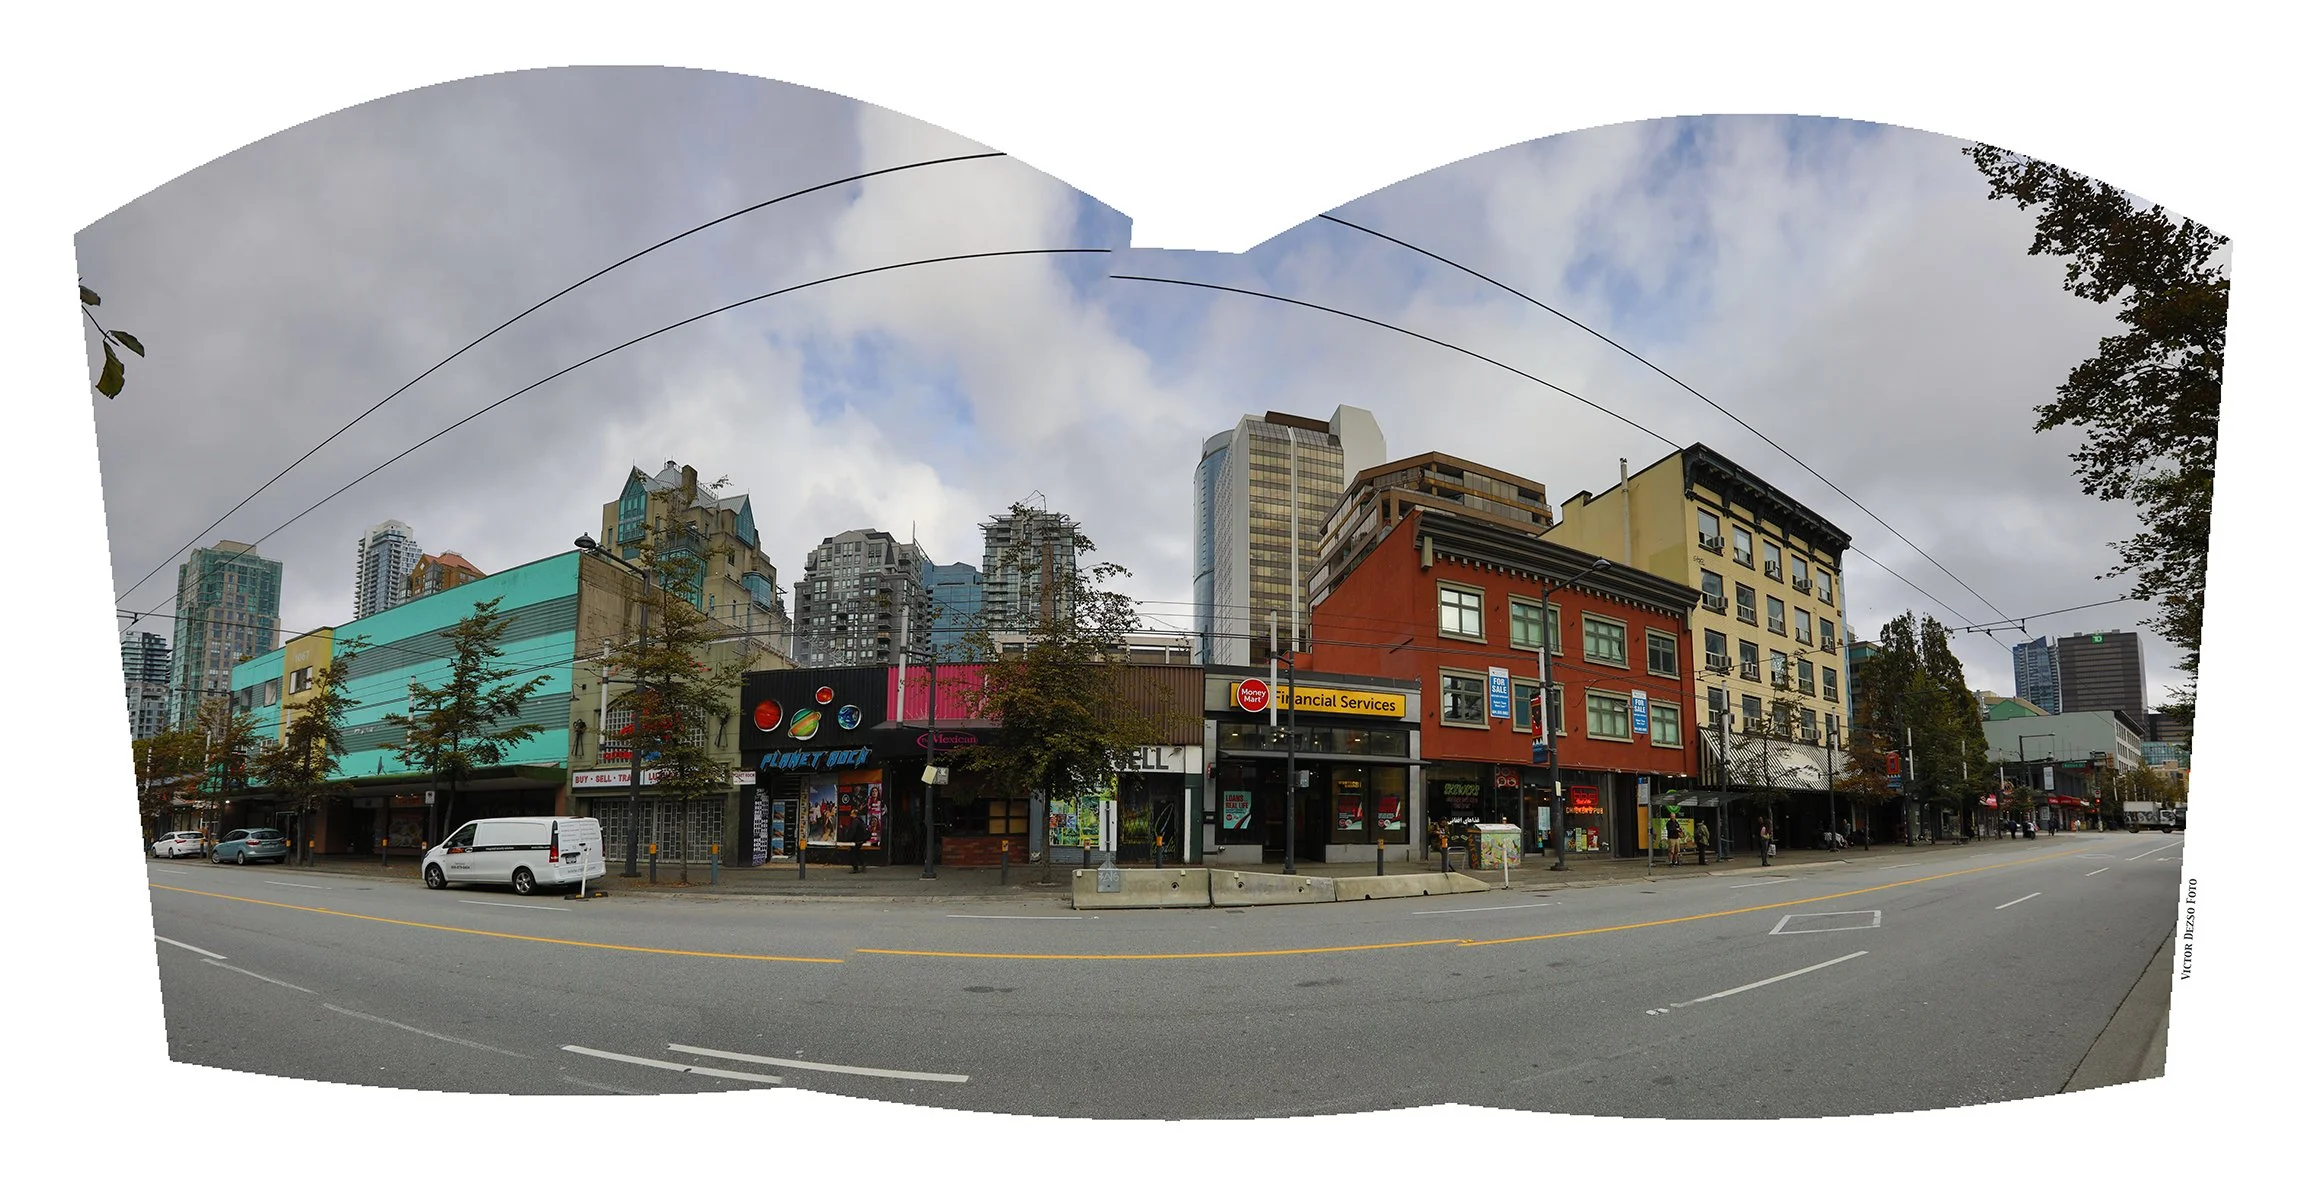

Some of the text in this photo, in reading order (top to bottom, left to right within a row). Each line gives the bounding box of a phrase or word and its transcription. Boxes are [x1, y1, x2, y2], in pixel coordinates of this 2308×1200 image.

[1493, 677, 1505, 686] FOR
[1241, 688, 1267, 698] Money
[1491, 685, 1507, 694] SALE
[1243, 695, 1261, 703] Mart
[1340, 695, 1396, 712] Services
[1634, 698, 1645, 706] FOR
[1634, 705, 1646, 714] SALE
[933, 732, 976, 744] Mexican
[760, 745, 873, 771] PLANET ROCK
[575, 776, 588, 784] BUY
[596, 775, 612, 783] SELL
[1239, 801, 1249, 809] LIFE
